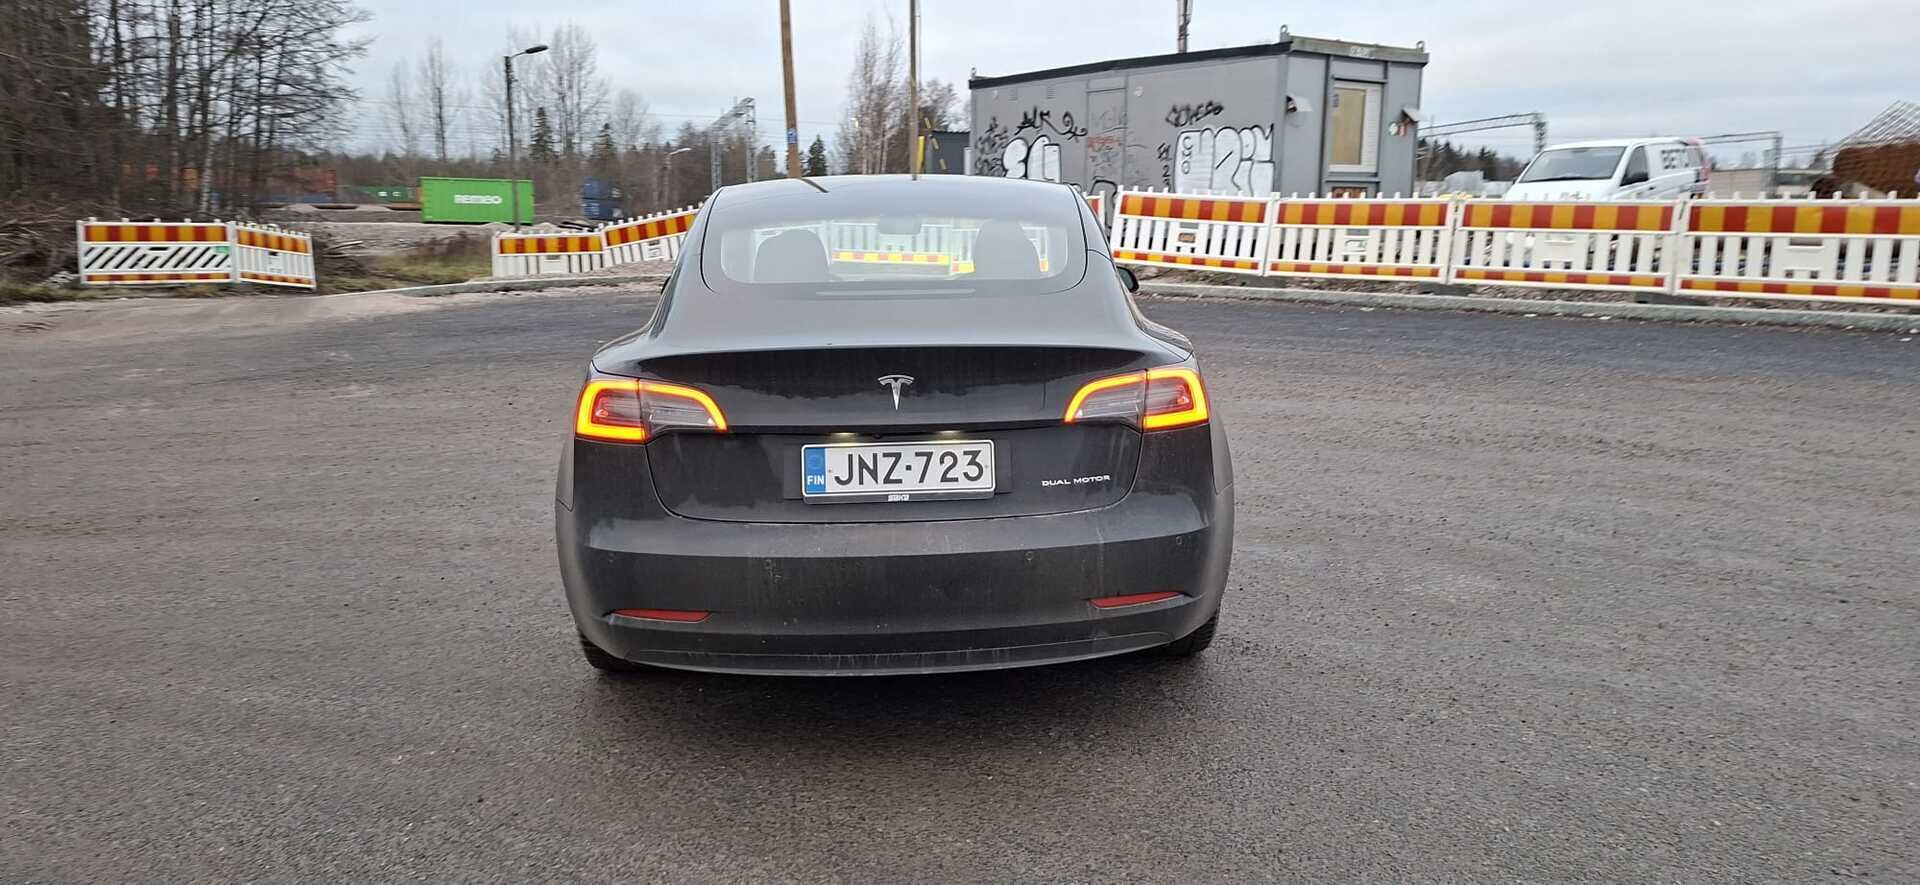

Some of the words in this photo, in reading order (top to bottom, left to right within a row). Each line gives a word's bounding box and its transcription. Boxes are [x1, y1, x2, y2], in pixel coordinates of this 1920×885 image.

[833, 449, 984, 486] JNZ-723
[807, 475, 825, 486] FIN
[1040, 479, 1071, 487] DUAL
[1073, 474, 1111, 484] MOTOR
